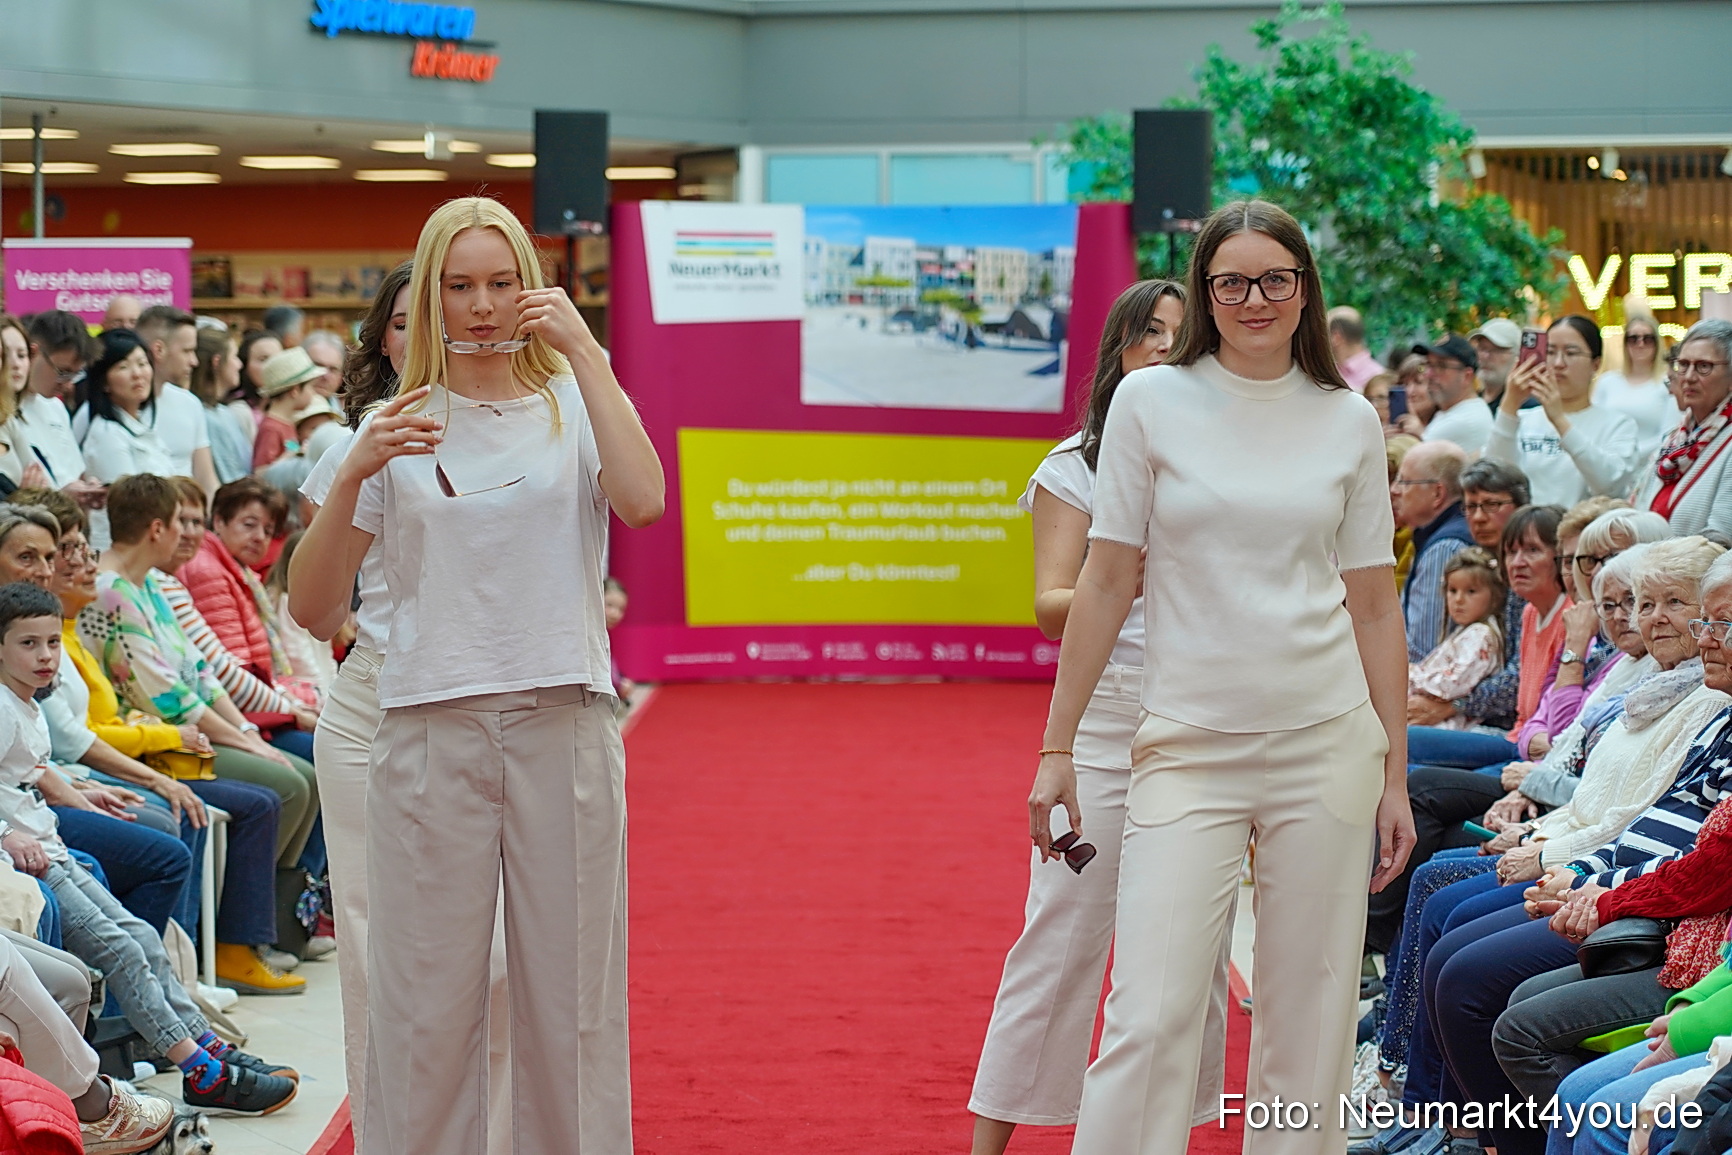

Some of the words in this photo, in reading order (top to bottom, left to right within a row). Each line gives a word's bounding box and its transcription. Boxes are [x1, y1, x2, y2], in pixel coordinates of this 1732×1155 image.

[310, 0, 476, 39] Spielwaren
[411, 40, 500, 82] Krämer
[14, 268, 139, 291] Verschenken
[140, 268, 174, 291] Sie
[727, 478, 754, 498] Du
[830, 479, 848, 500] ja
[850, 479, 896, 497] nicht
[899, 481, 921, 497] an
[978, 478, 1008, 497] Ort
[711, 500, 776, 520] Schuhe
[847, 502, 879, 519] ein
[880, 501, 955, 519] Workout
[725, 524, 761, 542] und
[762, 523, 826, 542] deinen
[827, 522, 938, 542] Traumurlaub
[847, 562, 875, 582] Du
